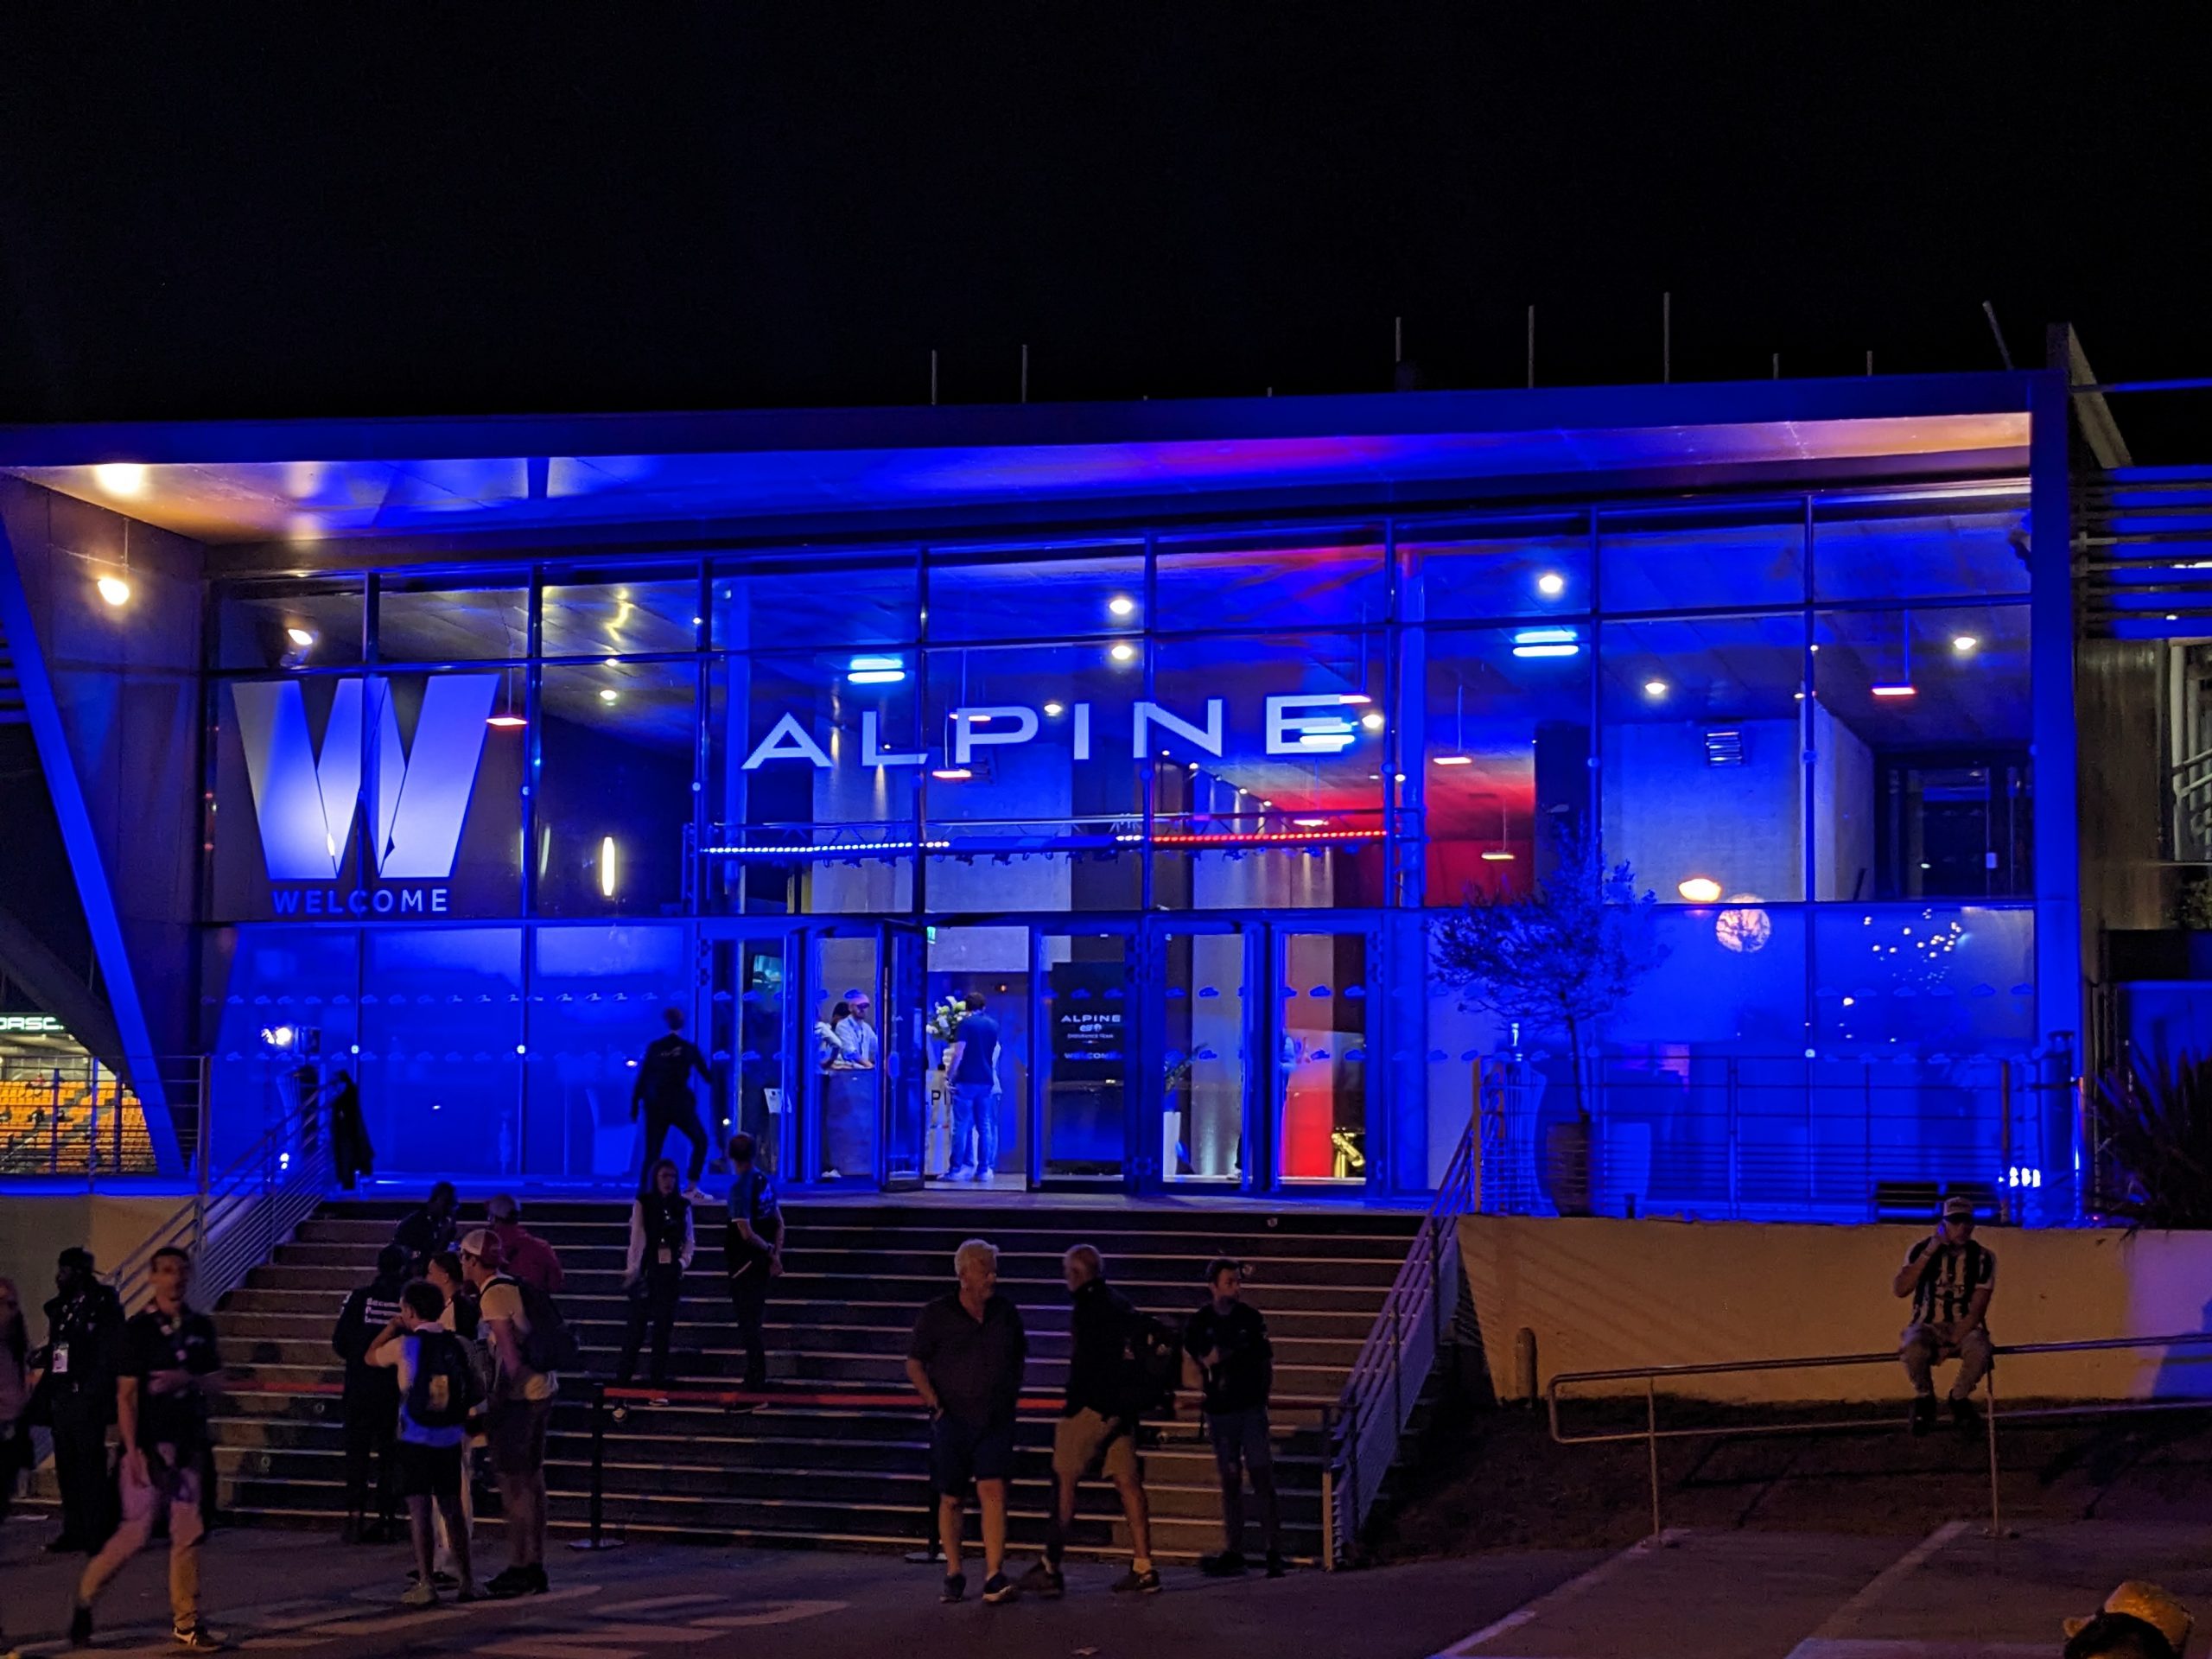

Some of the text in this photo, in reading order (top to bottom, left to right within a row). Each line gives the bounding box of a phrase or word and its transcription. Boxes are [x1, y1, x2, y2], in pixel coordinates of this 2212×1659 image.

[741, 693, 1344, 770] ALPINE
[272, 888, 448, 914] WELCOME
[1060, 1014, 1122, 1023] ALPINE
